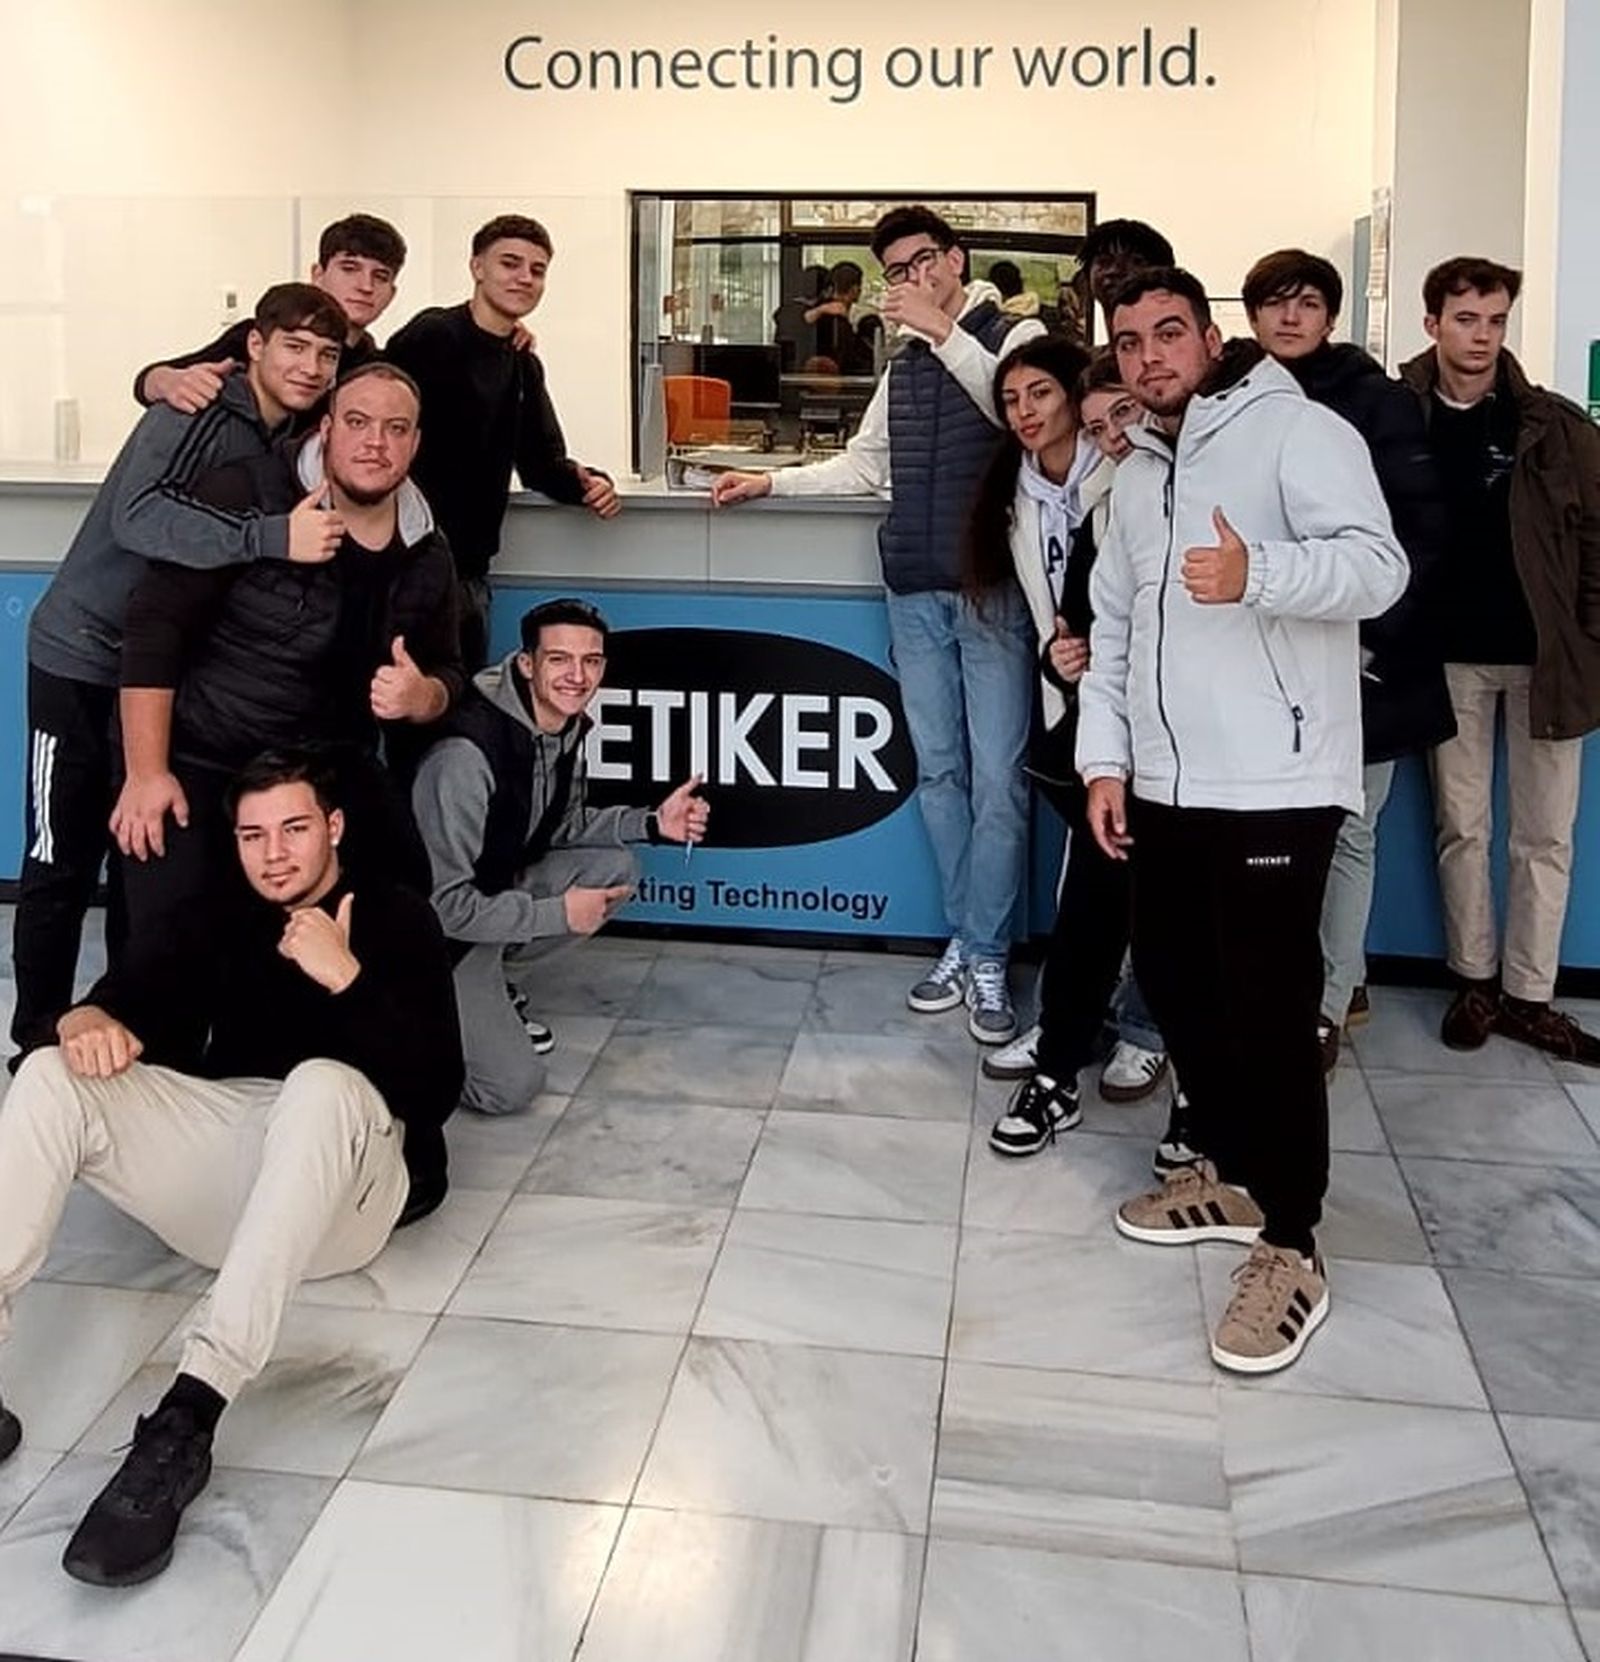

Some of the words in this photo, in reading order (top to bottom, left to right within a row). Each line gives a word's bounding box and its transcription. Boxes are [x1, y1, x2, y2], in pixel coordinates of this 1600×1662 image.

[504, 34, 862, 103] Connecting
[885, 46, 993, 88] our
[1013, 27, 1217, 88] world.
[586, 688, 898, 792] ETIKER
[629, 876, 696, 911] ting
[707, 880, 888, 919] Technology
